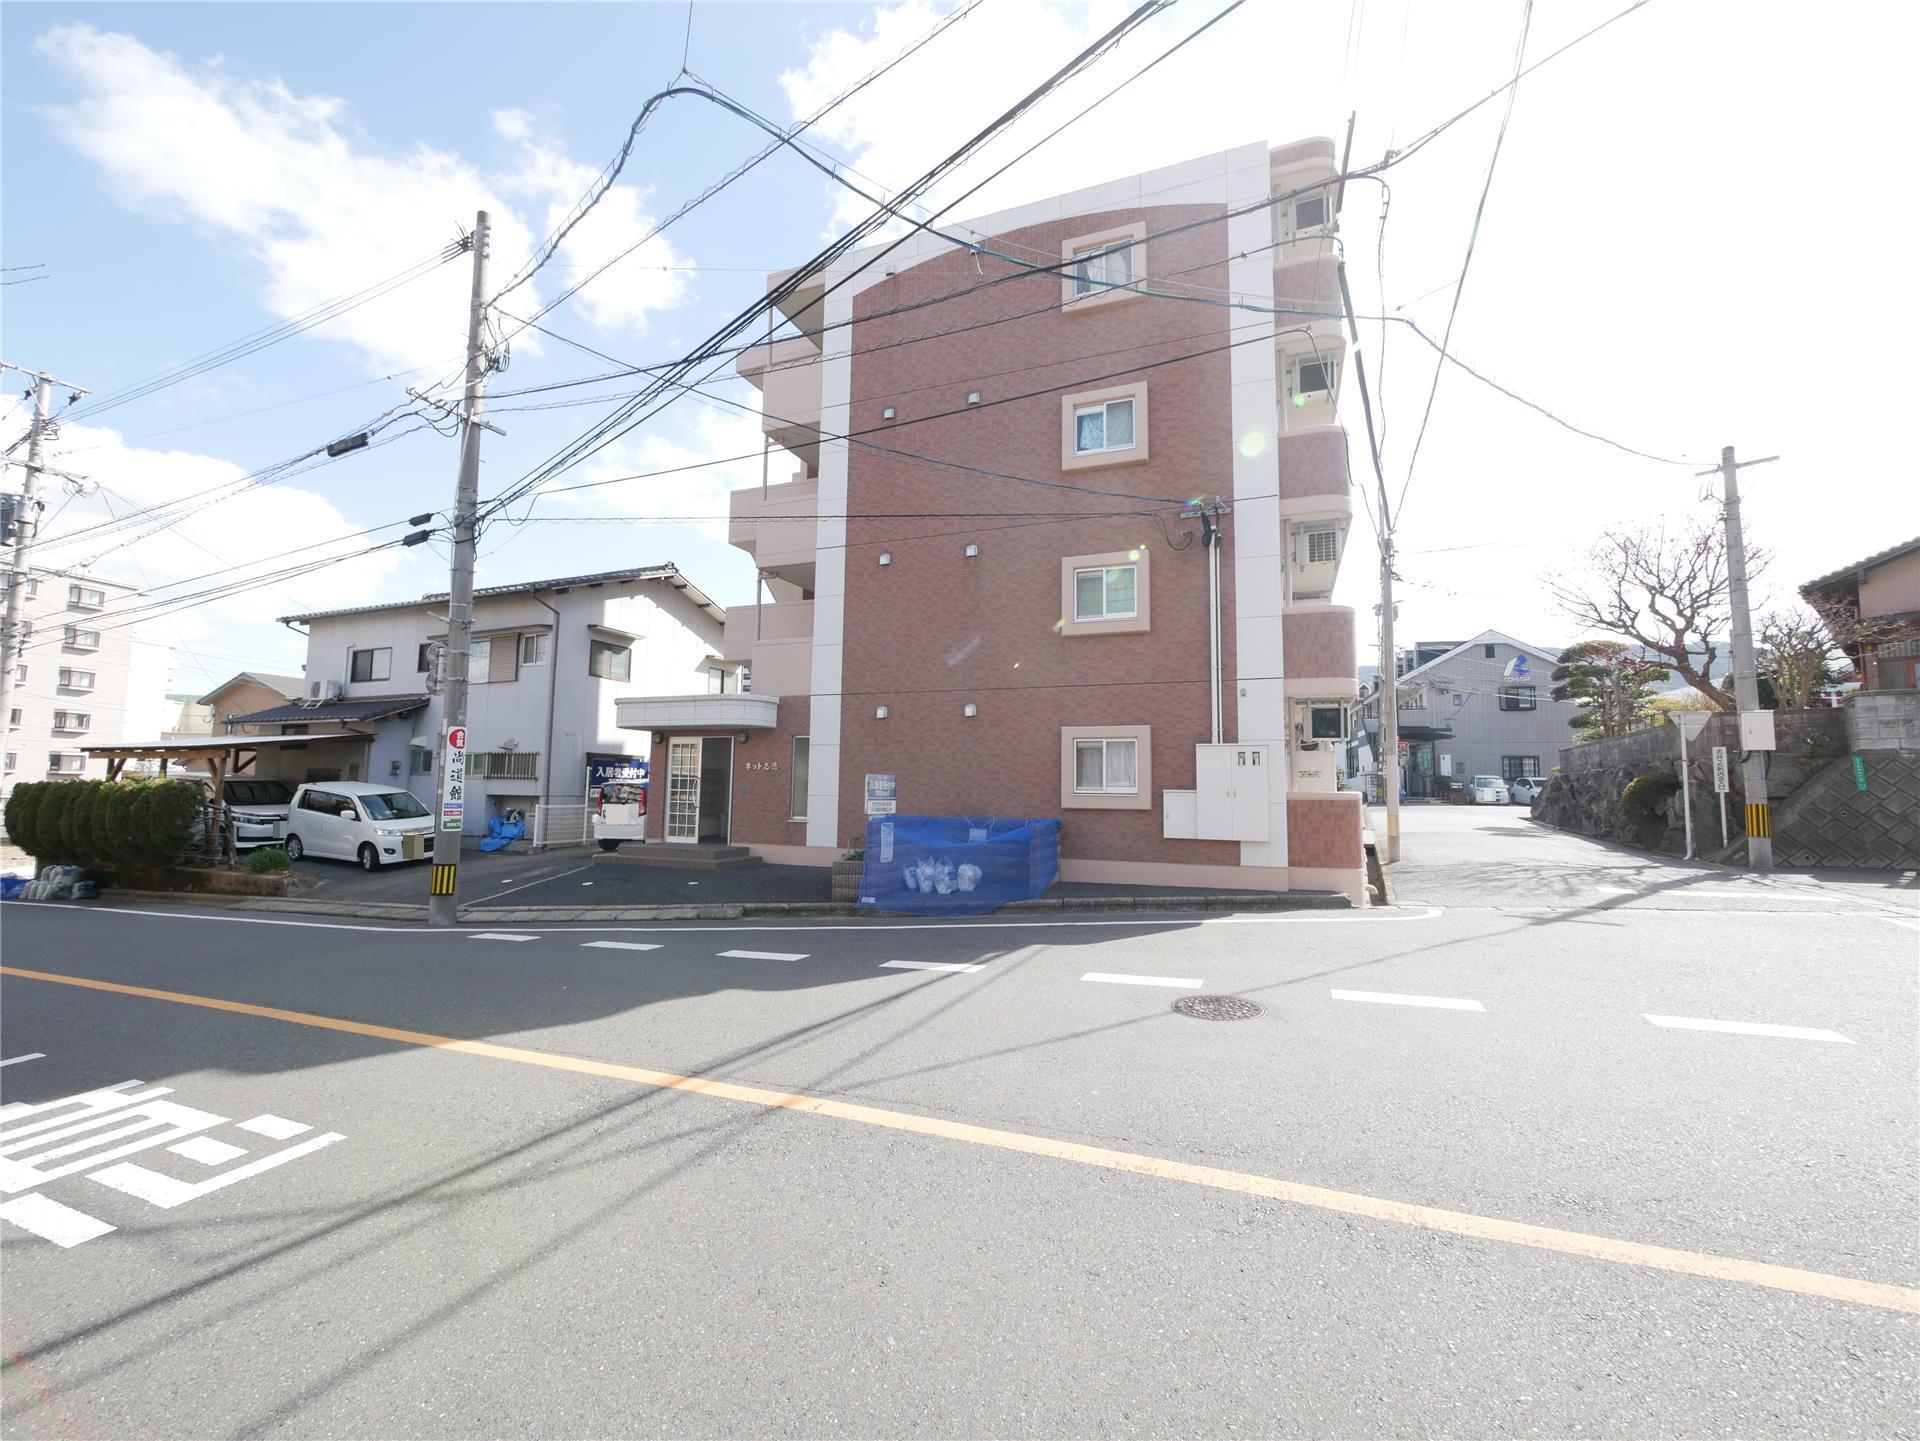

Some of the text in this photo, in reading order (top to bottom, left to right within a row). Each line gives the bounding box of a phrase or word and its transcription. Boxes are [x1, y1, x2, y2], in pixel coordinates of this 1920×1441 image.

[449, 750, 465, 802] 尚道館
[596, 766, 646, 779] 入居者受付中
